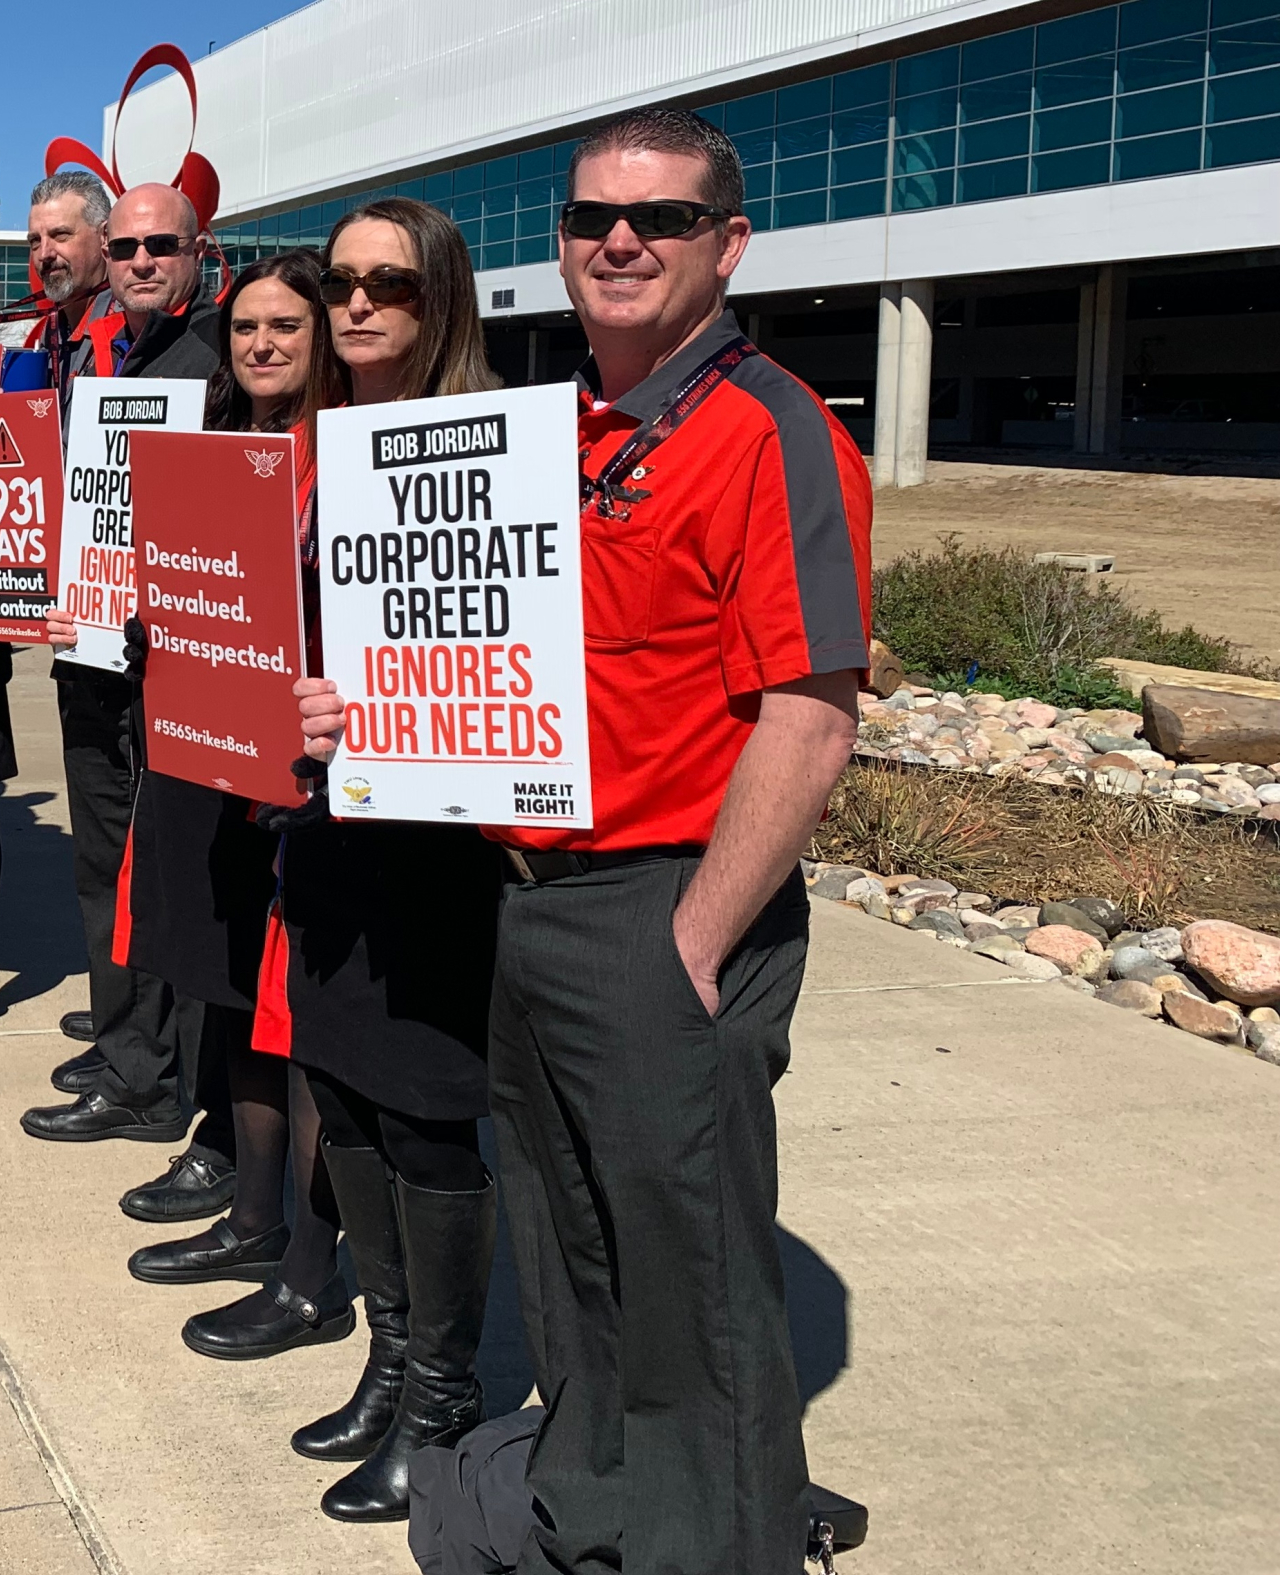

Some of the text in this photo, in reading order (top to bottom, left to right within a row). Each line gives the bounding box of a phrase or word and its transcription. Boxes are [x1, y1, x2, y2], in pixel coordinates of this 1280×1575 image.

[102, 400, 164, 420] BOB JORDAN
[675, 368, 722, 417] 556 STRIKES BACK
[105, 429, 129, 467] YO
[380, 421, 499, 462] BOB JORDAN
[70, 466, 132, 508] CORPO
[387, 468, 492, 526] YOUR
[92, 507, 131, 547] GRE
[79, 545, 137, 589] IGNOR
[145, 540, 245, 579] Deceived.
[331, 522, 560, 586] CORPORATE
[66, 582, 104, 624] OUR
[147, 582, 252, 624] Devalued.
[382, 584, 510, 640] GREED
[150, 623, 293, 675] Disrespected.
[364, 643, 533, 698] IGNORES
[154, 717, 259, 758] #556StrikesBack
[344, 701, 562, 758] OUR NEEDS
[513, 782, 574, 797] MAKE IT
[514, 799, 574, 815] RIGHT!
